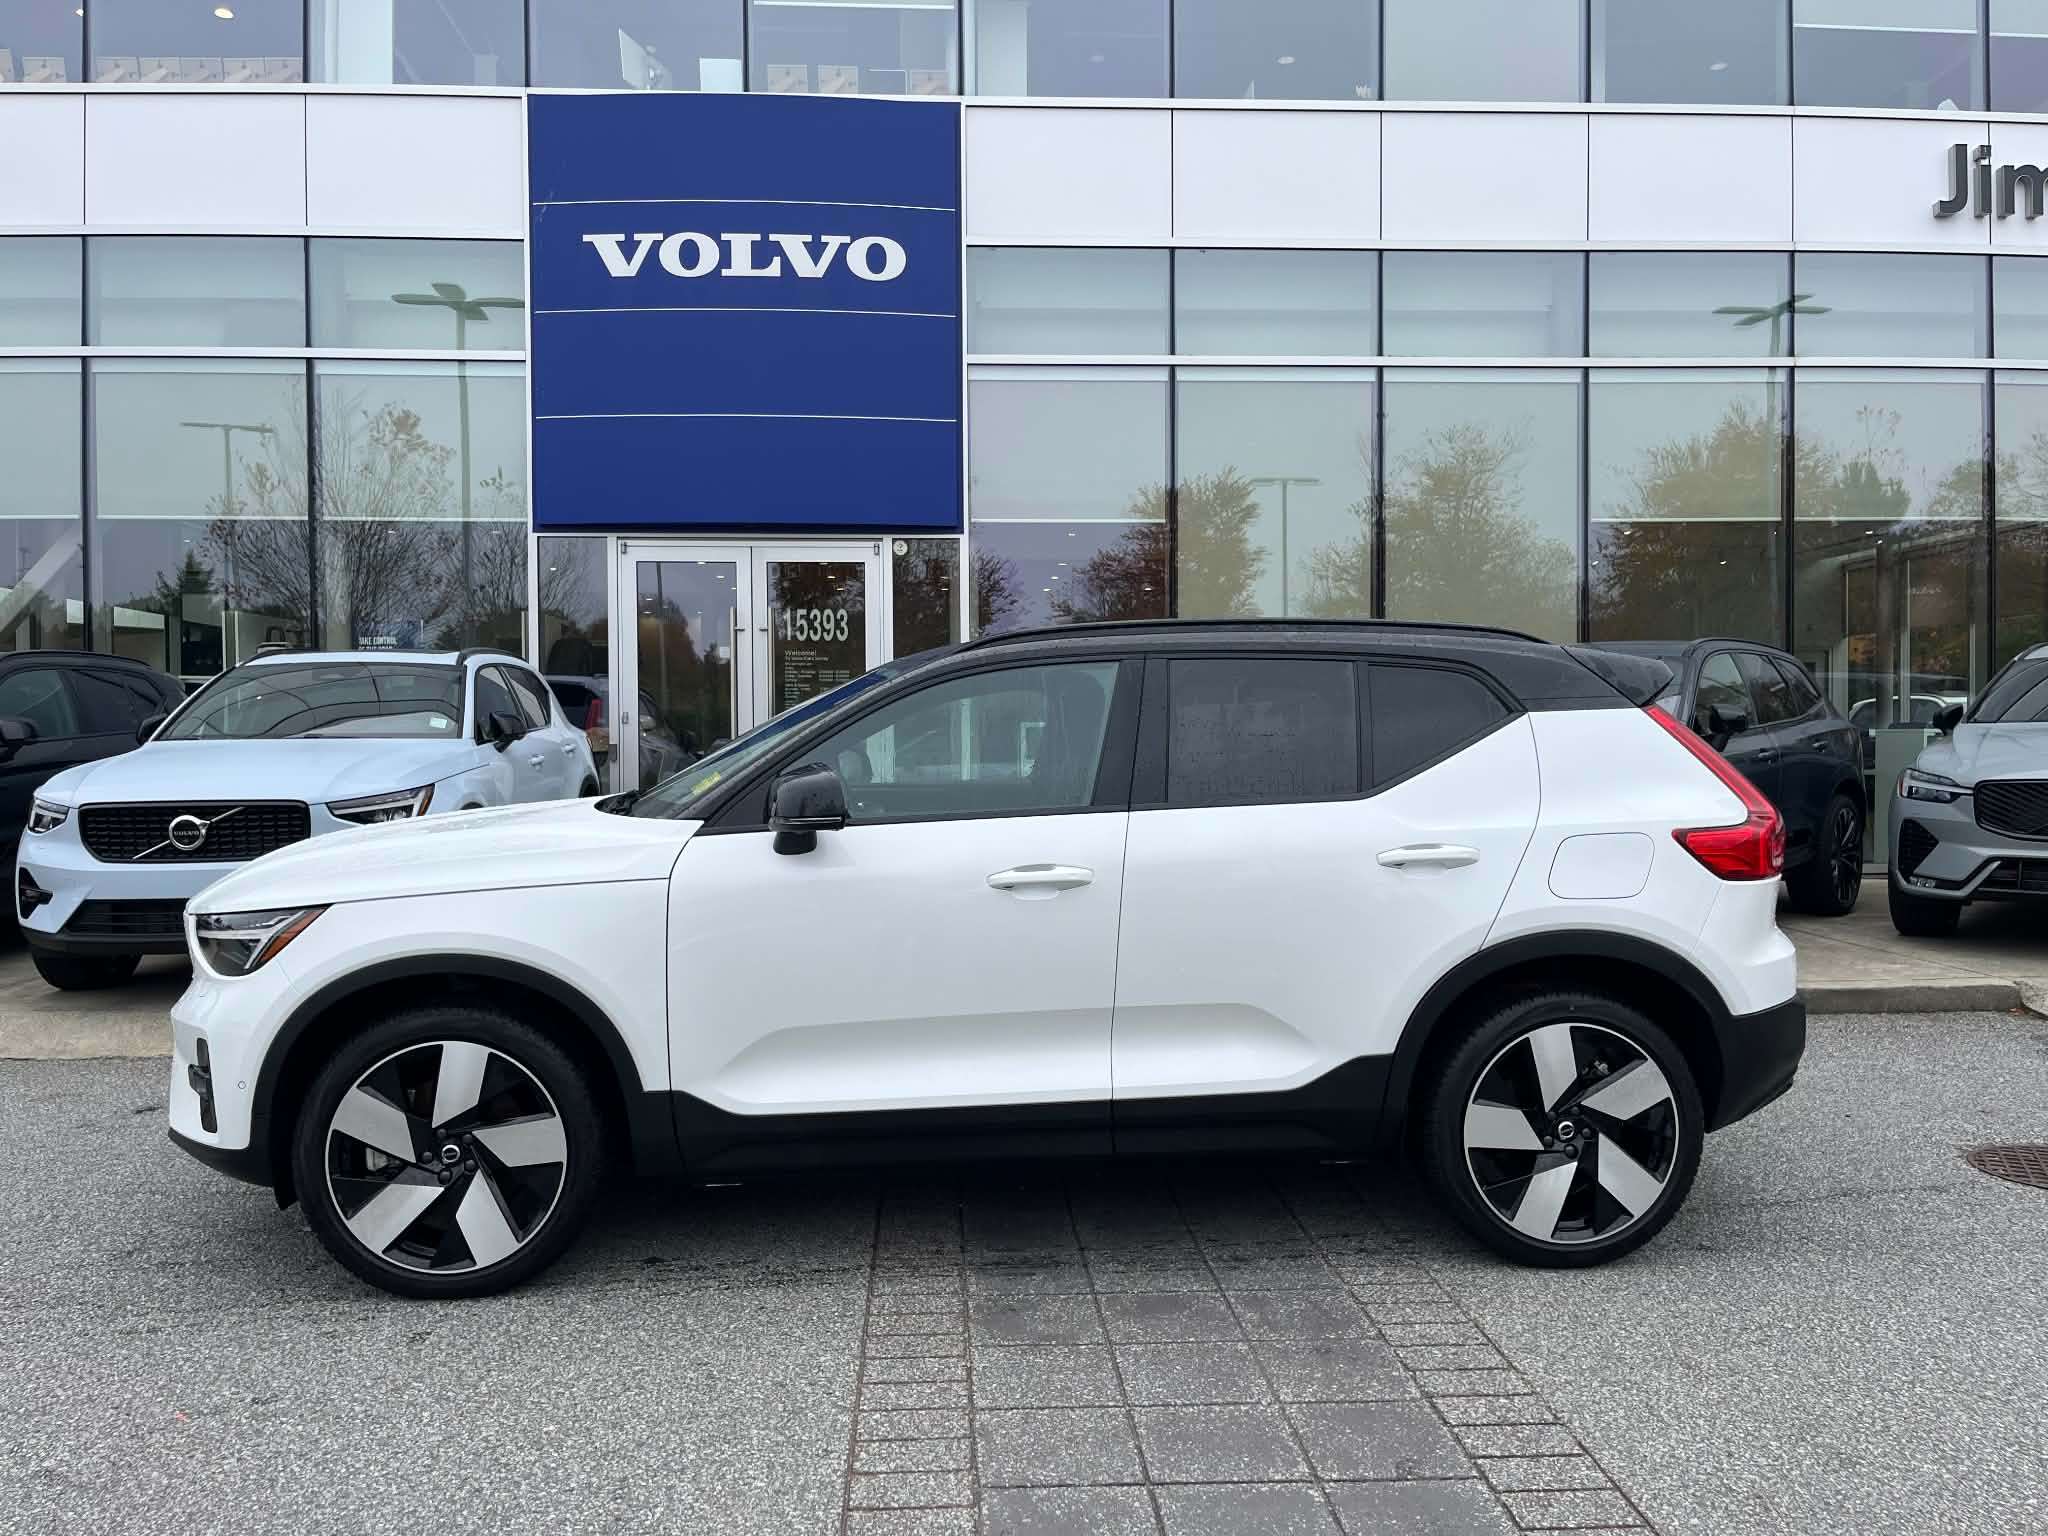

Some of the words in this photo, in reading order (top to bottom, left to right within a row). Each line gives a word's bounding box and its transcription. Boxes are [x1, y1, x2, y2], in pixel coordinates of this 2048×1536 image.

[1932, 143, 2048, 219] Jim
[582, 232, 907, 281] VOLVO
[784, 608, 849, 641] 15393
